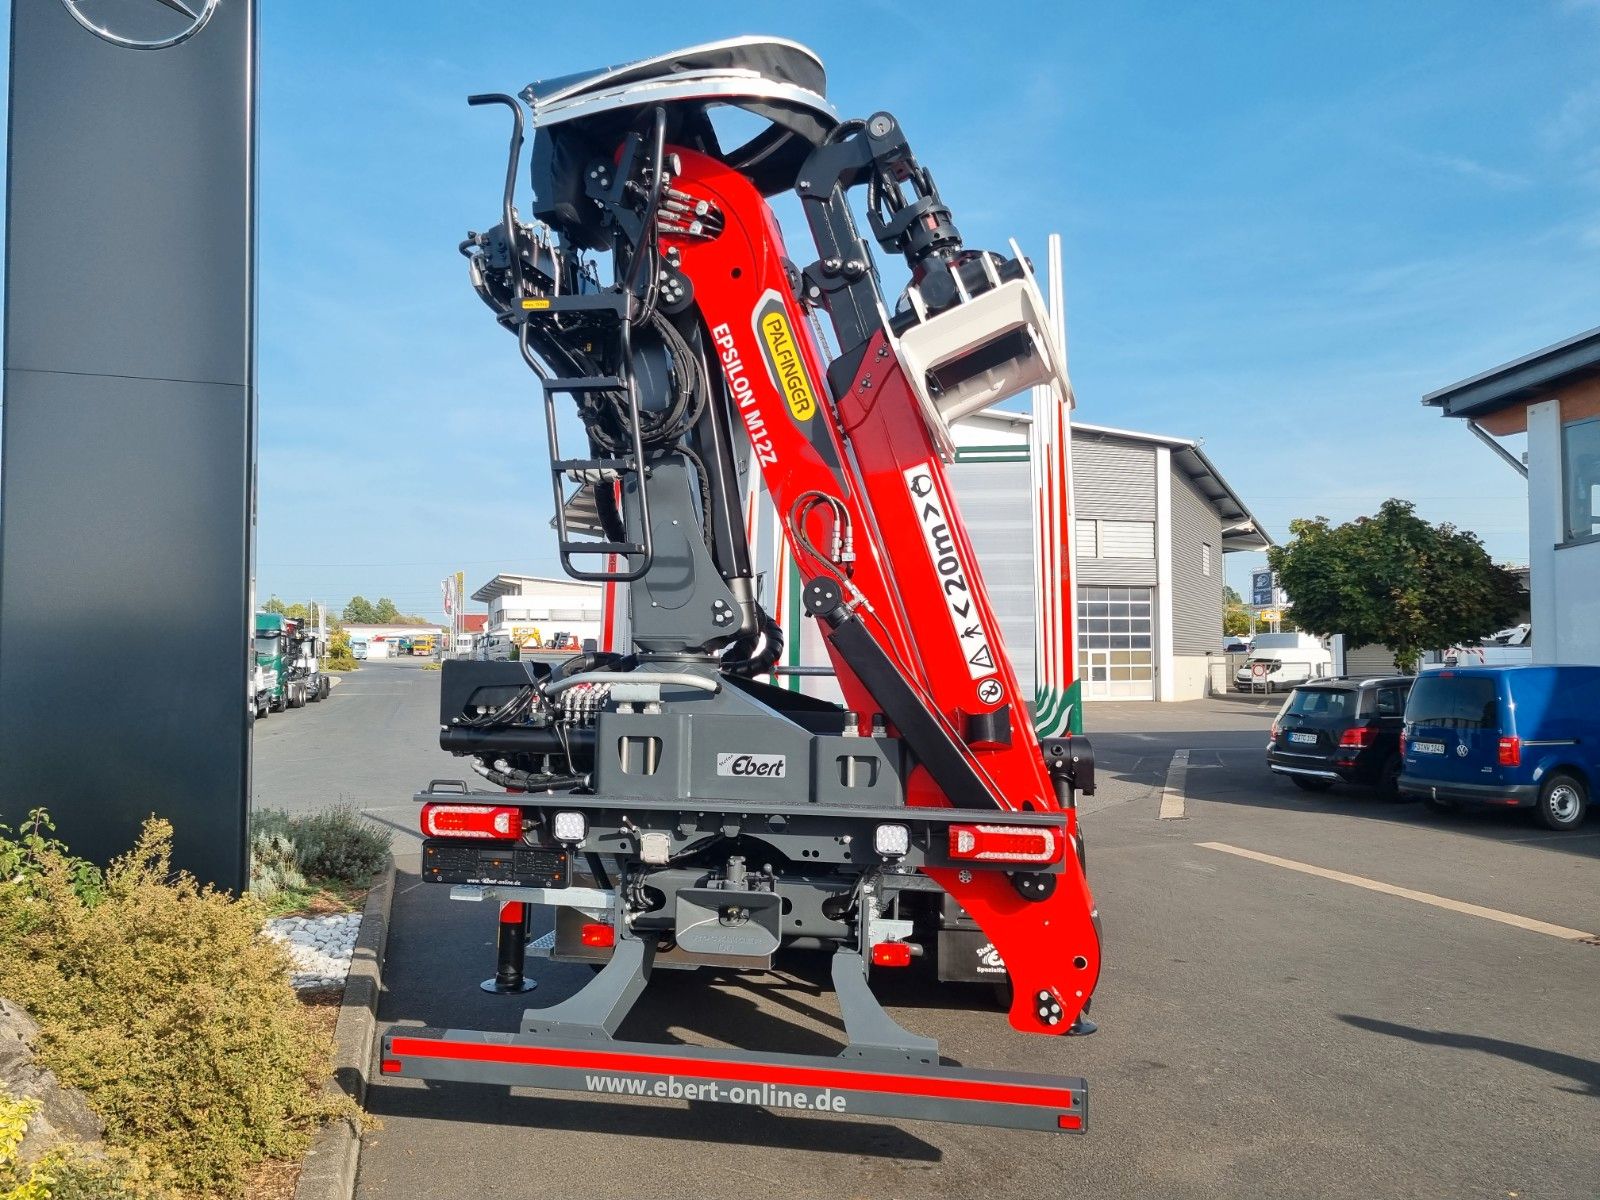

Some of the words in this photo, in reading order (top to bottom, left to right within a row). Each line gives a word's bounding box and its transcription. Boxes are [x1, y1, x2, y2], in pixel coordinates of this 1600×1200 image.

[712, 322, 756, 408] EPSILON
[744, 409, 778, 468] M12Z
[766, 318, 811, 414] PALFINGER
[732, 755, 784, 776] Ebert
[585, 1074, 847, 1112] www.ebert-online.de
